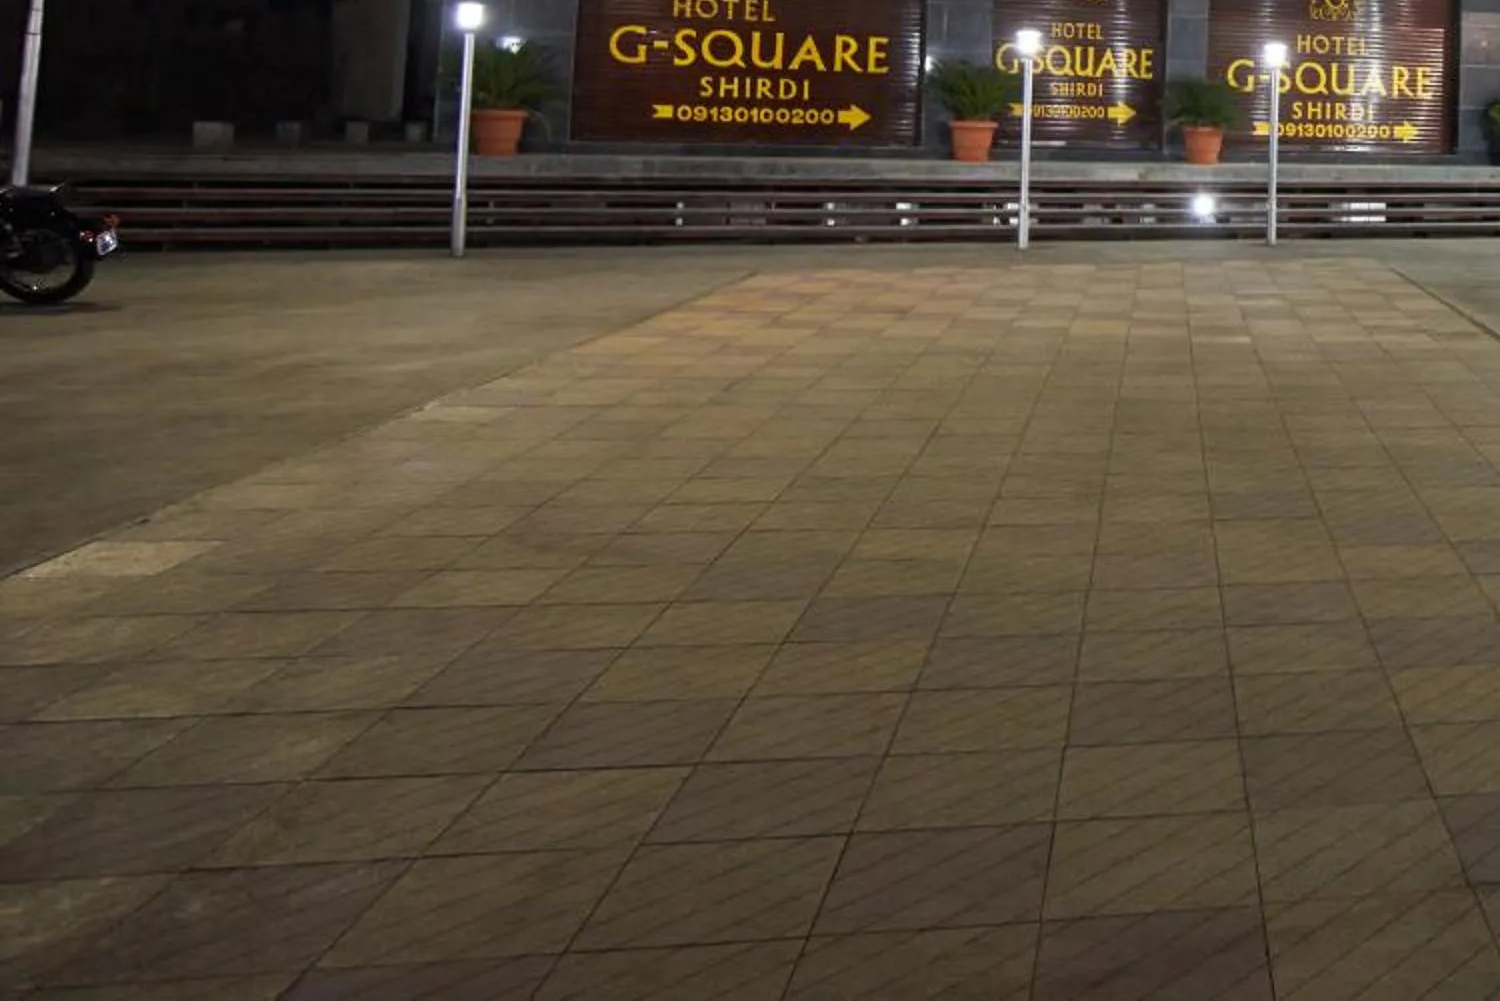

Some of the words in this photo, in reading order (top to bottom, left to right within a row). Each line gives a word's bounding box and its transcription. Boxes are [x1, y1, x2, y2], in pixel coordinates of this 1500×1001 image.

[1051, 22, 1104, 40] HOTEL
[609, 24, 890, 74] G-SQUARE
[1296, 33, 1367, 55] HOTEL
[700, 75, 810, 100] SHIRDI
[1050, 81, 1103, 97] SHIRDI
[676, 104, 835, 125] 09130100200
[1292, 102, 1374, 120] SHIRDI
